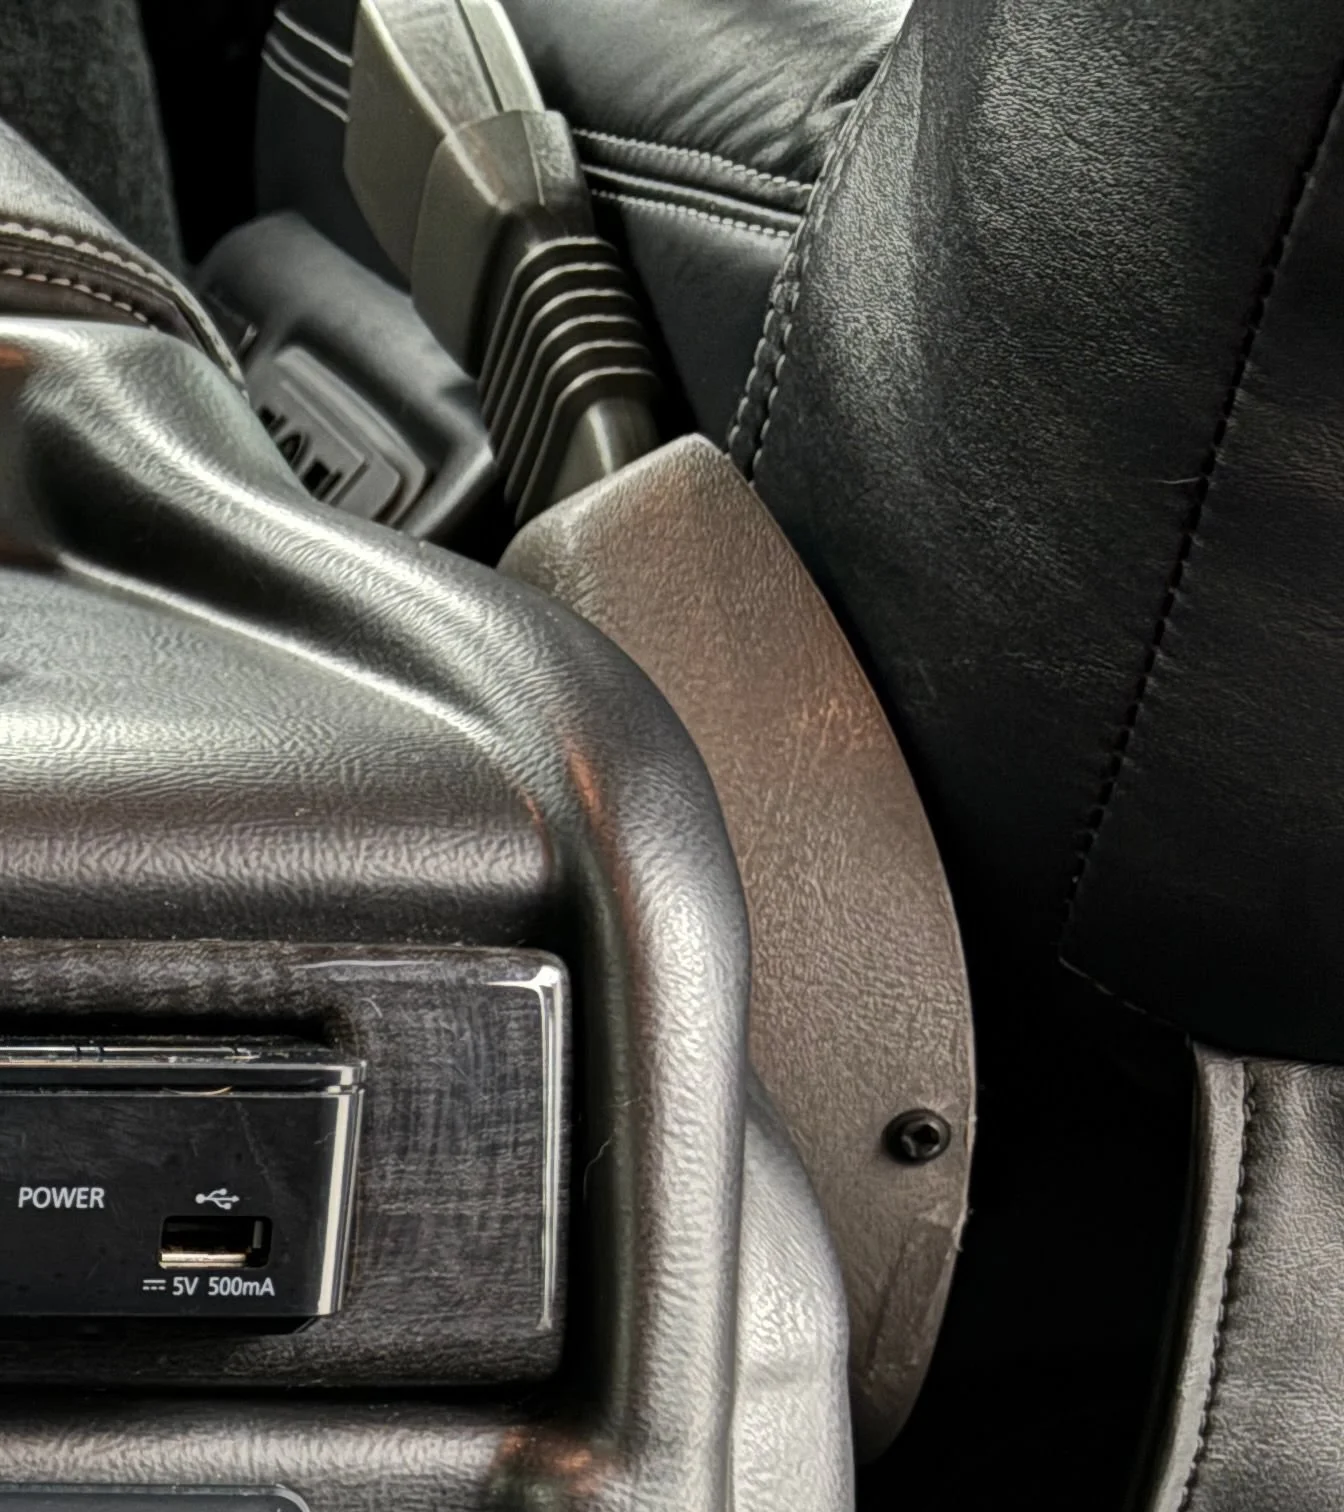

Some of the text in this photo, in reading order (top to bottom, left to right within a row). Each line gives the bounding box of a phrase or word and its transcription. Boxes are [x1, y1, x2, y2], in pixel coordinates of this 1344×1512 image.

[18, 1186, 106, 1210] POWER
[172, 1276, 276, 1297] 5V 500mA
